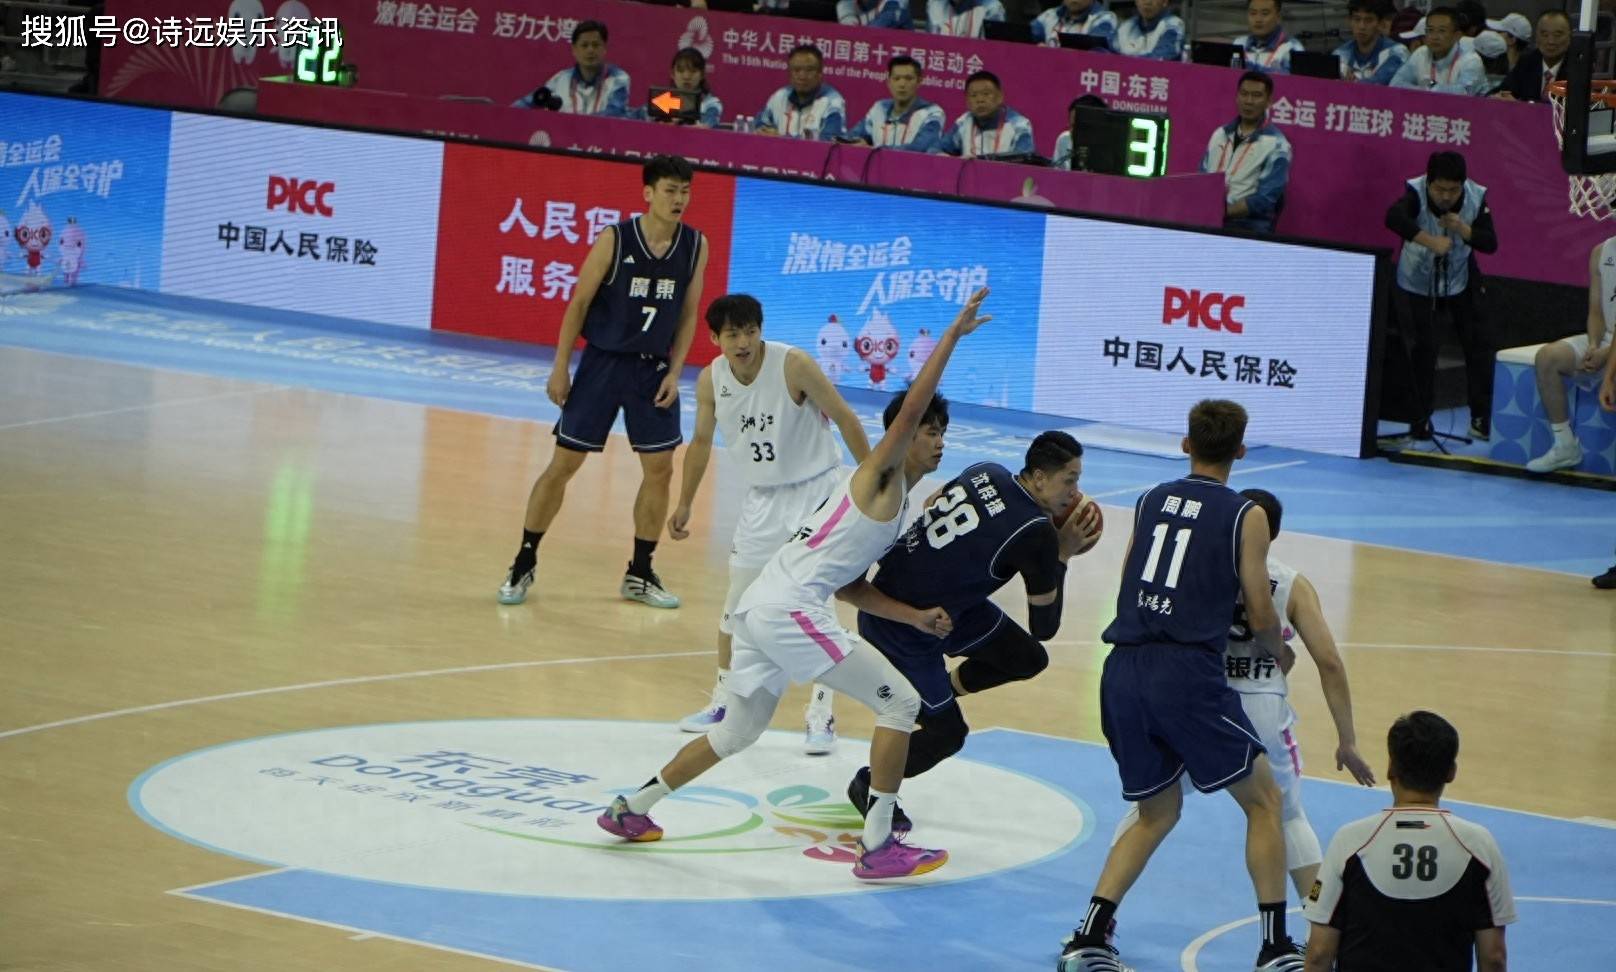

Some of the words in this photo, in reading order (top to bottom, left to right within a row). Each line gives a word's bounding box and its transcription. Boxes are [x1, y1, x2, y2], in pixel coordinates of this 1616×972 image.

[374, 1, 479, 34] 激情全运会
[763, 58, 787, 70] Natio
[1081, 68, 1169, 101] 中国·东莞
[1266, 96, 1317, 128] 全运
[1325, 103, 1393, 137] 打篮球
[1402, 112, 1471, 146] 进莞来
[15, 160, 124, 208] 人保全守护
[266, 175, 335, 218] PICC
[499, 197, 643, 245] 人民保
[218, 221, 379, 266] 中国人民保险
[781, 232, 912, 275] 激情全运会
[629, 276, 676, 300] 廣東
[856, 264, 989, 315] 人保全守护
[641, 306, 657, 332] 7
[1162, 286, 1245, 334] PICC
[1103, 335, 1298, 389] 中国人民保险
[750, 442, 775, 462] 33
[924, 484, 980, 550] 28
[1161, 495, 1202, 520] 周鹏
[1140, 523, 1192, 589] 11
[1226, 654, 1277, 680] 银行
[396, 750, 598, 790] 东莞
[1392, 843, 1439, 882] 38
